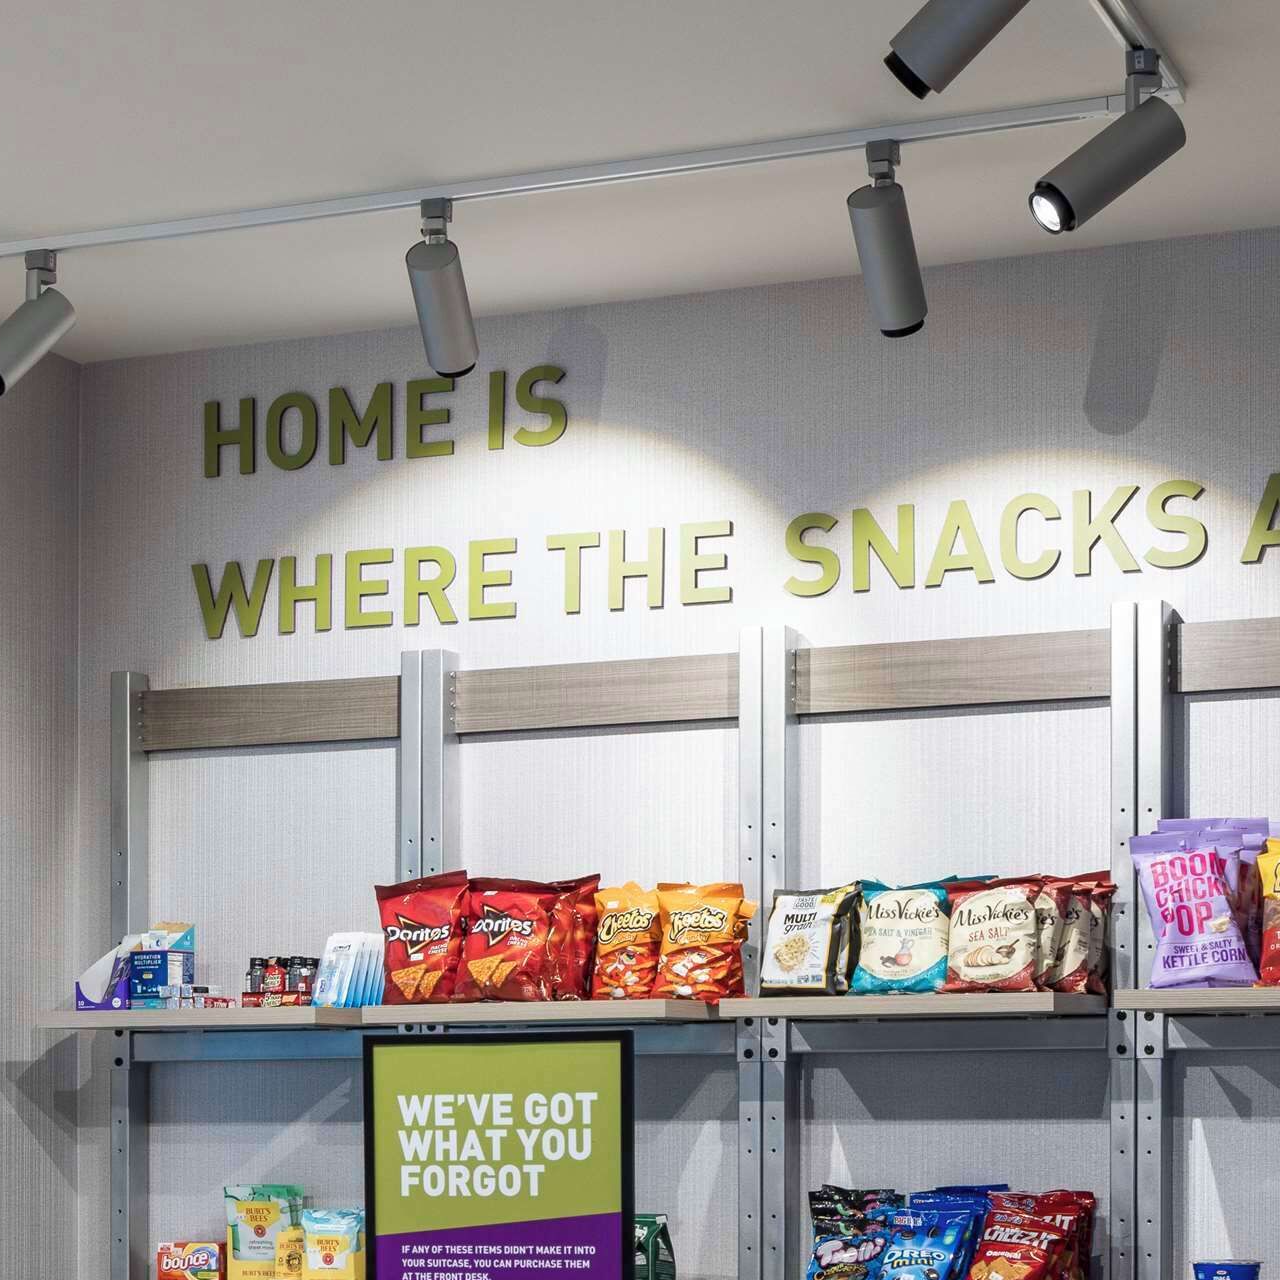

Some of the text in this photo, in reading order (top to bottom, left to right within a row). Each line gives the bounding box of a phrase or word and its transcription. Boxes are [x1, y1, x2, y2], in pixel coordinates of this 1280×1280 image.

[202, 364, 569, 479] HOME IS
[191, 536, 519, 640] WHERE
[546, 519, 734, 616] THE
[782, 478, 1209, 599] SNACKS
[784, 912, 818, 925] MULTI
[896, 897, 940, 921] Vickie's
[953, 899, 1029, 928] Miss Vickie's
[1160, 901, 1214, 937] POP
[387, 923, 451, 943] Doritos
[599, 909, 653, 944] Cheetos
[784, 922, 813, 935] grain
[968, 927, 1010, 943] SEA SALT
[1173, 943, 1199, 954] SWEET
[1209, 939, 1232, 949] SALTY
[1162, 948, 1246, 969] KETTLE CORN
[397, 1092, 598, 1127] WE'VE GOT
[398, 1128, 592, 1161] WHAT YOU
[400, 1164, 546, 1198] FORGOT
[245, 1207, 271, 1216] BURT'S
[401, 1245, 596, 1255] IF ANY OF THESE ITEMS DIDN'T MAKE IT INTO
[883, 1249, 946, 1265] OREO
[162, 1251, 210, 1272] bounce
[402, 1259, 590, 1269] YOUR SUITCASE, YOU CAN PURCHASE THEM
[892, 1258, 934, 1269] mini
